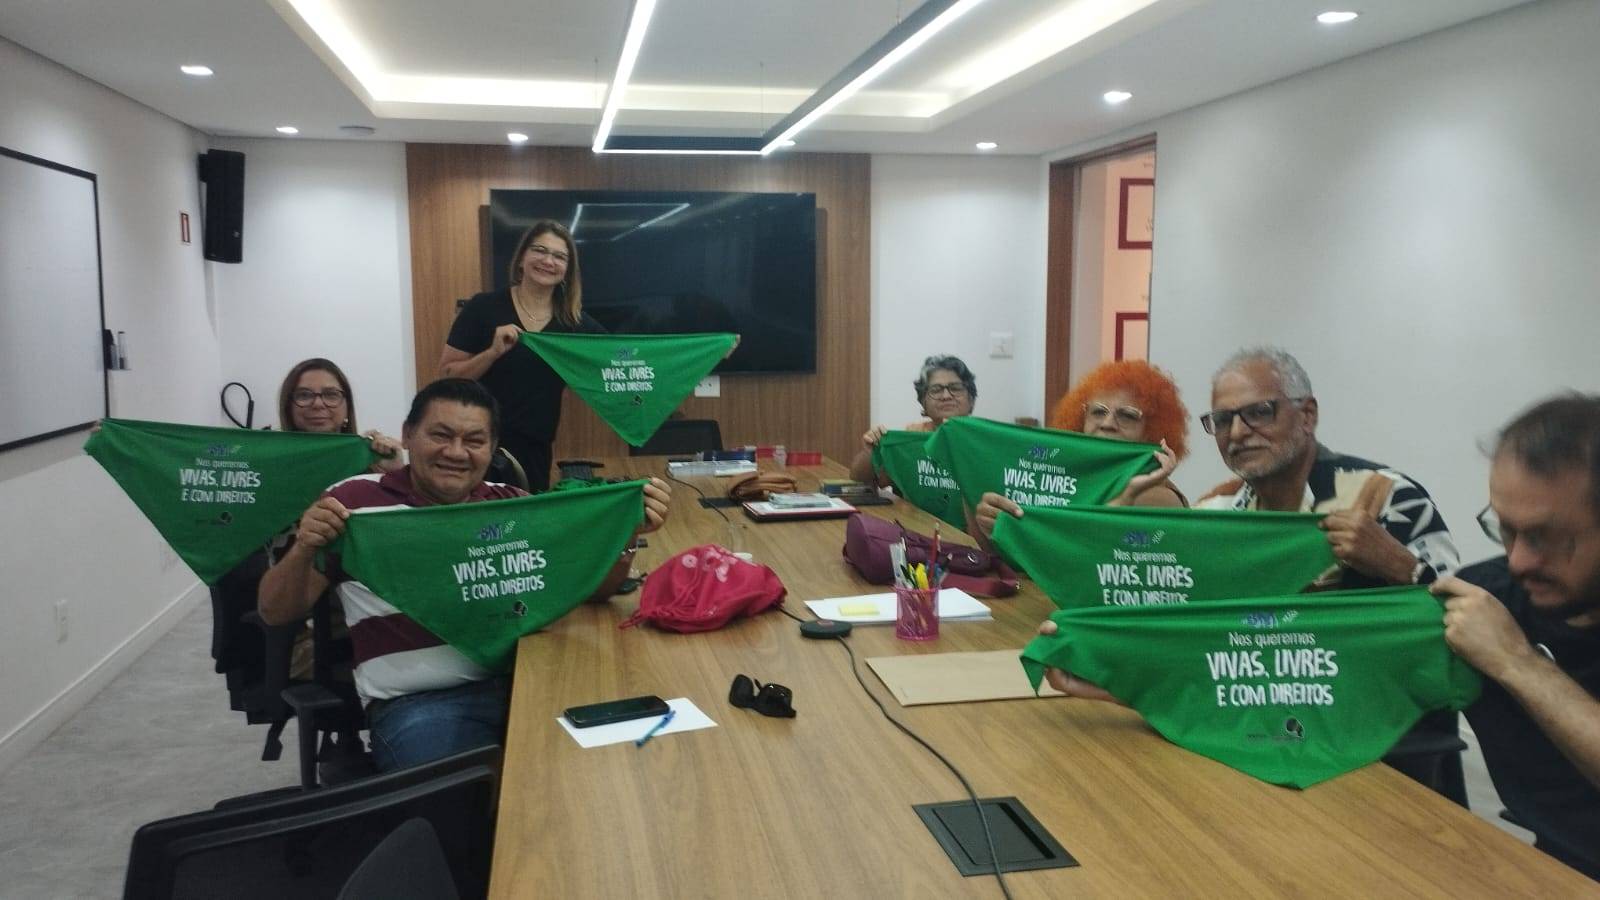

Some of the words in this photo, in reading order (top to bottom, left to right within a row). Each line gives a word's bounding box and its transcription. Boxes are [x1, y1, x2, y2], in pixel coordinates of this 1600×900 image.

[629, 366, 655, 380] LIVRES
[604, 382, 609, 392] E
[610, 382, 626, 392] COM
[626, 381, 653, 391] DIREITOS
[222, 471, 261, 488] LIVRES
[918, 475, 923, 485] E
[924, 476, 938, 488] COM
[1040, 474, 1077, 495] LIVRES
[182, 489, 189, 501] E
[191, 489, 214, 502] COM
[215, 491, 256, 503] DIREITOS
[1005, 488, 1011, 499] E
[1011, 490, 1033, 505] COM
[502, 550, 547, 575] LIVRES
[1146, 565, 1194, 588] LIVRES
[461, 586, 470, 601] E
[471, 583, 498, 599] COM
[500, 575, 545, 595] DIREITOS
[1103, 589, 1111, 605] E
[1113, 589, 1140, 606] COM
[1254, 633, 1316, 648] queremos
[1206, 651, 1270, 680] VIVAS,
[1274, 648, 1339, 678] LIVRES
[1217, 685, 1227, 706] E
[1230, 684, 1267, 706] COM
[1269, 683, 1334, 706] DIREITOS
